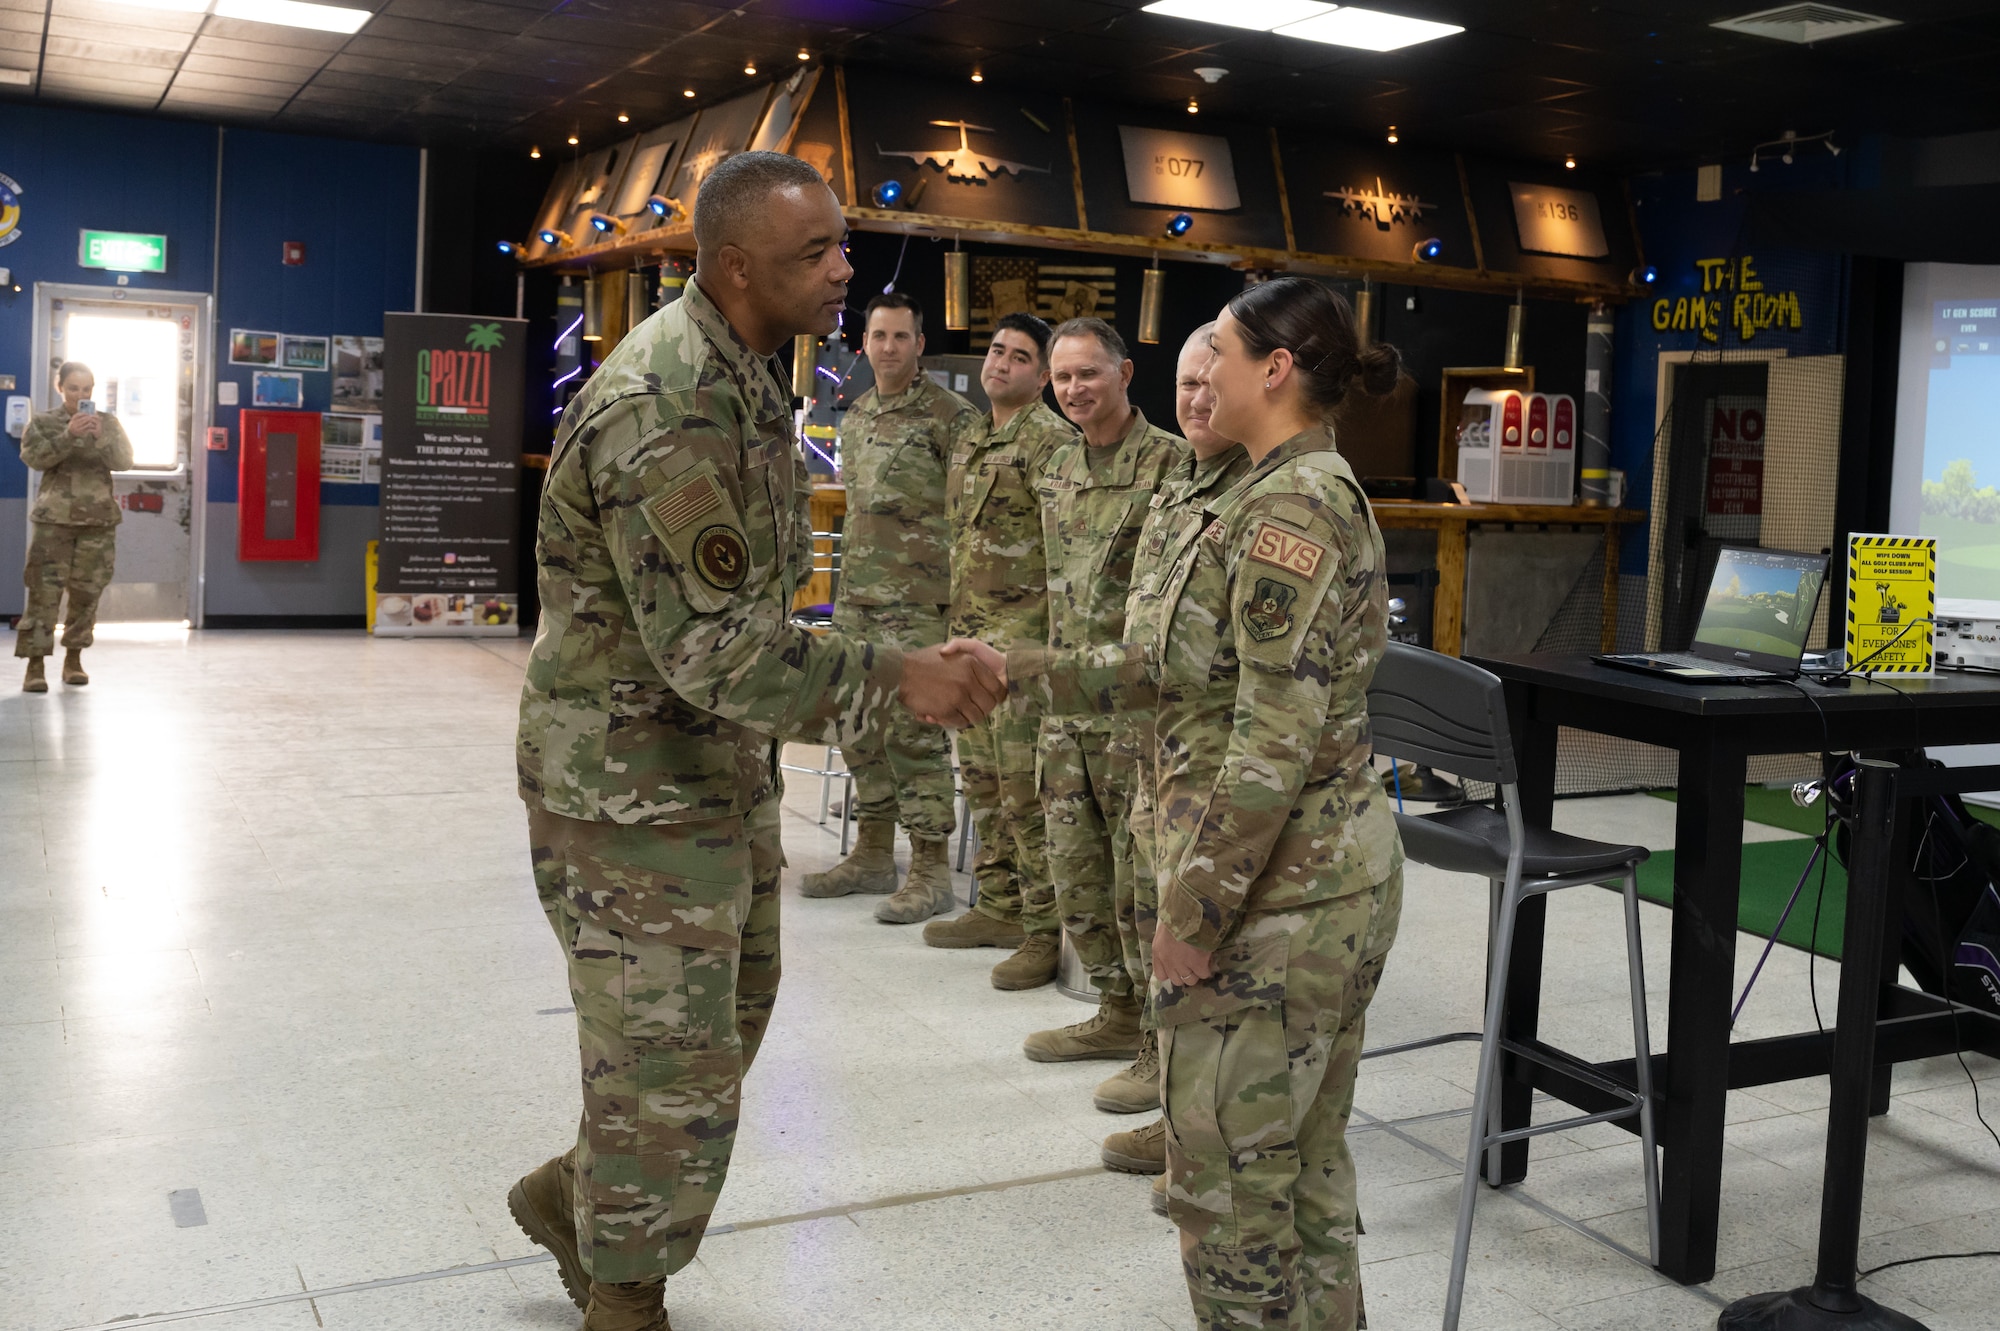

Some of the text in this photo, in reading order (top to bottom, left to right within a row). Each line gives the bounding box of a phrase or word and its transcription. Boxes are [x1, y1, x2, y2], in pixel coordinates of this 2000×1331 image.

[1168, 157, 1204, 178] 077
[1549, 202, 1578, 222] 136
[1695, 256, 1763, 292] THE
[1652, 291, 1802, 342] GAME ROOM
[1942, 308, 1951, 319] LT
[1953, 308, 1968, 318] GEN
[1713, 408, 1765, 441] NO
[423, 433, 437, 442] We
[415, 445, 490, 456] THE DROP ZONE
[1257, 530, 1317, 572] SVS
[1881, 627, 1899, 635] FOR
